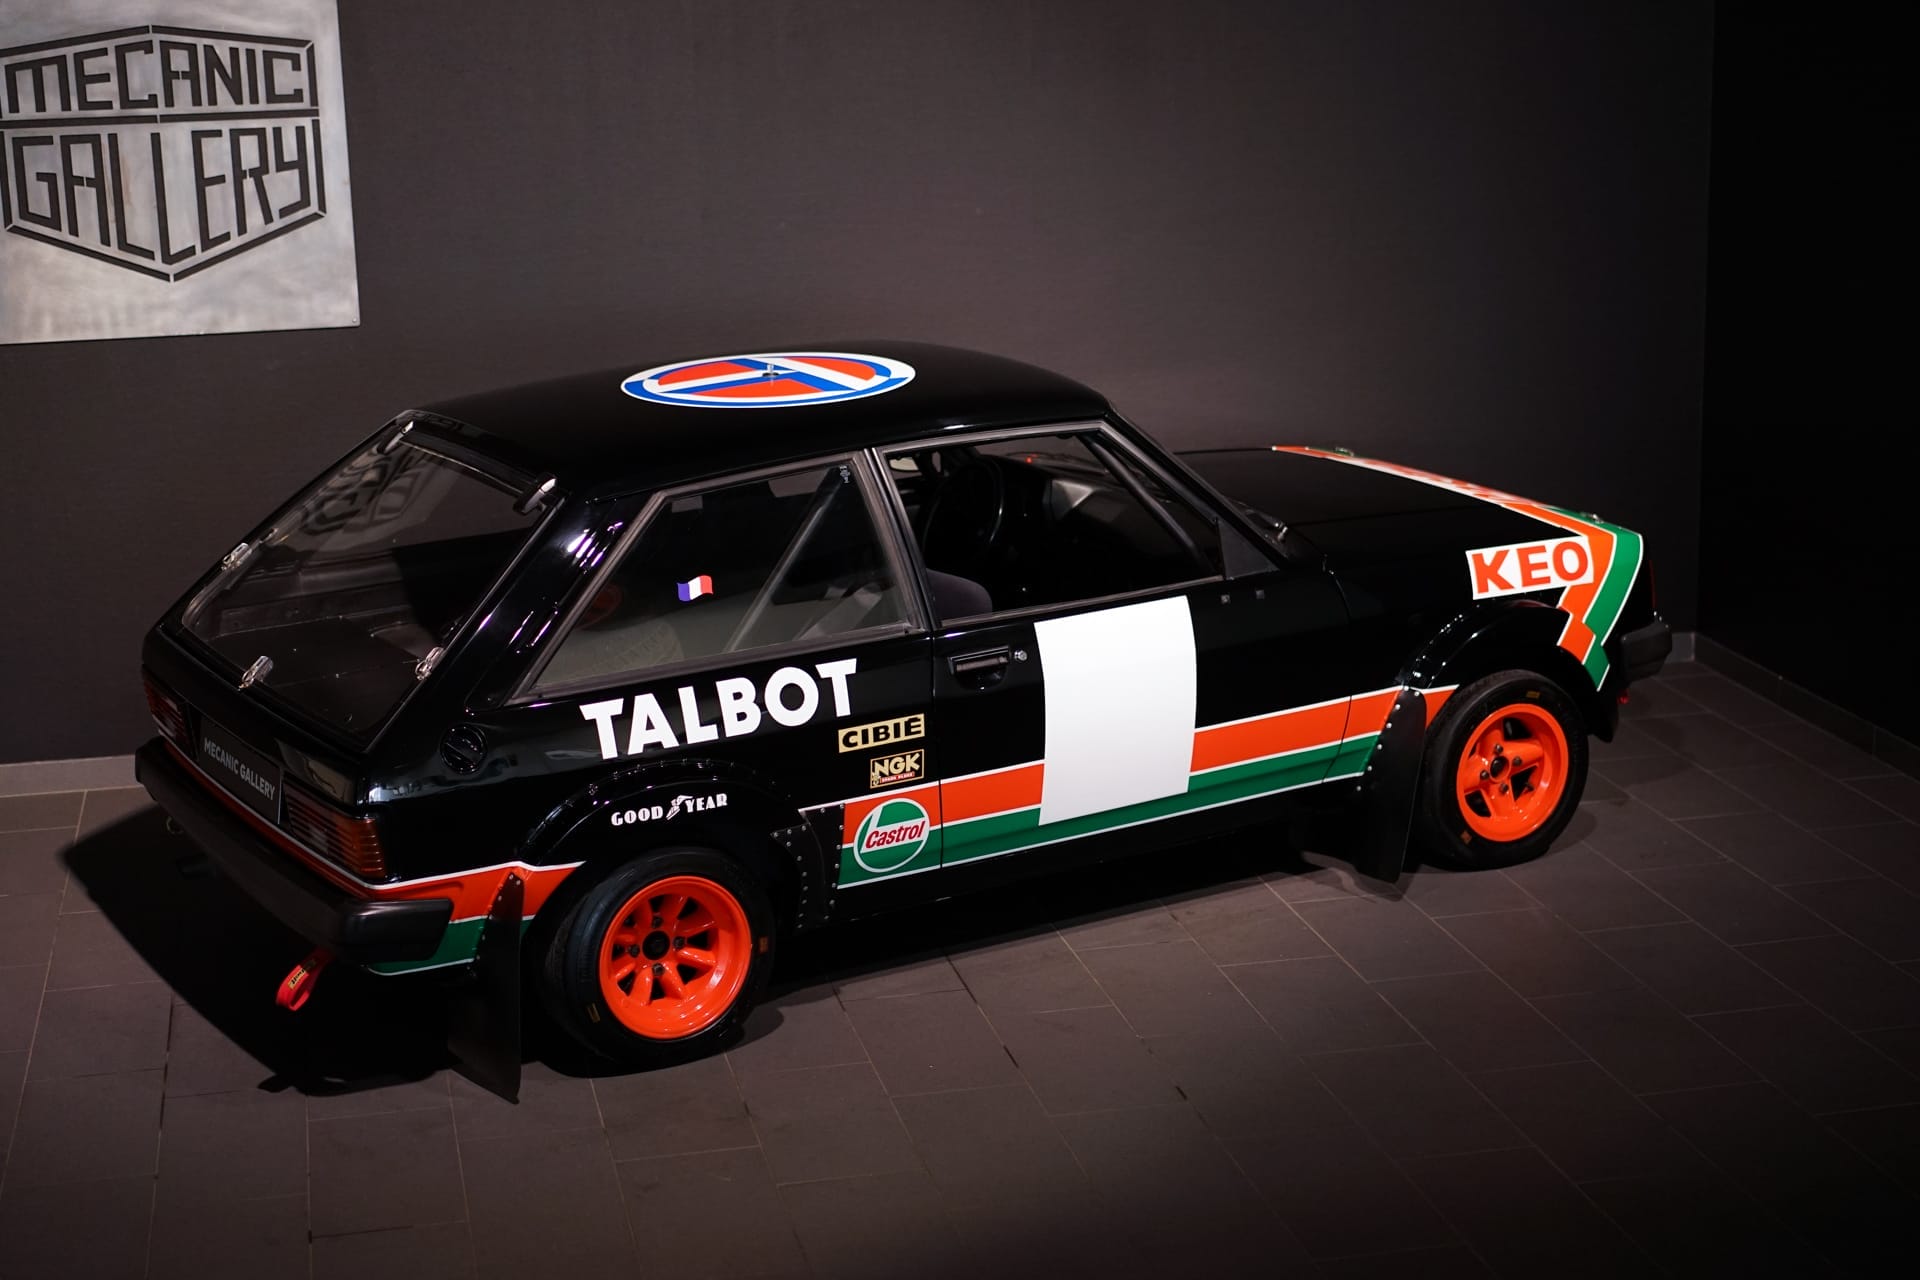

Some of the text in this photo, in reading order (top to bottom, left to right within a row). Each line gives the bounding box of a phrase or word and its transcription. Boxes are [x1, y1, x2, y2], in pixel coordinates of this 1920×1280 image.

[4, 39, 304, 114] MECANIC
[12, 125, 312, 265] GALLERY
[1471, 541, 1589, 594] KEO
[579, 658, 858, 760] TALBOT
[204, 737, 275, 800] MECANIC GALLERY
[874, 752, 920, 776] NGK
[865, 820, 926, 849] Castrol
